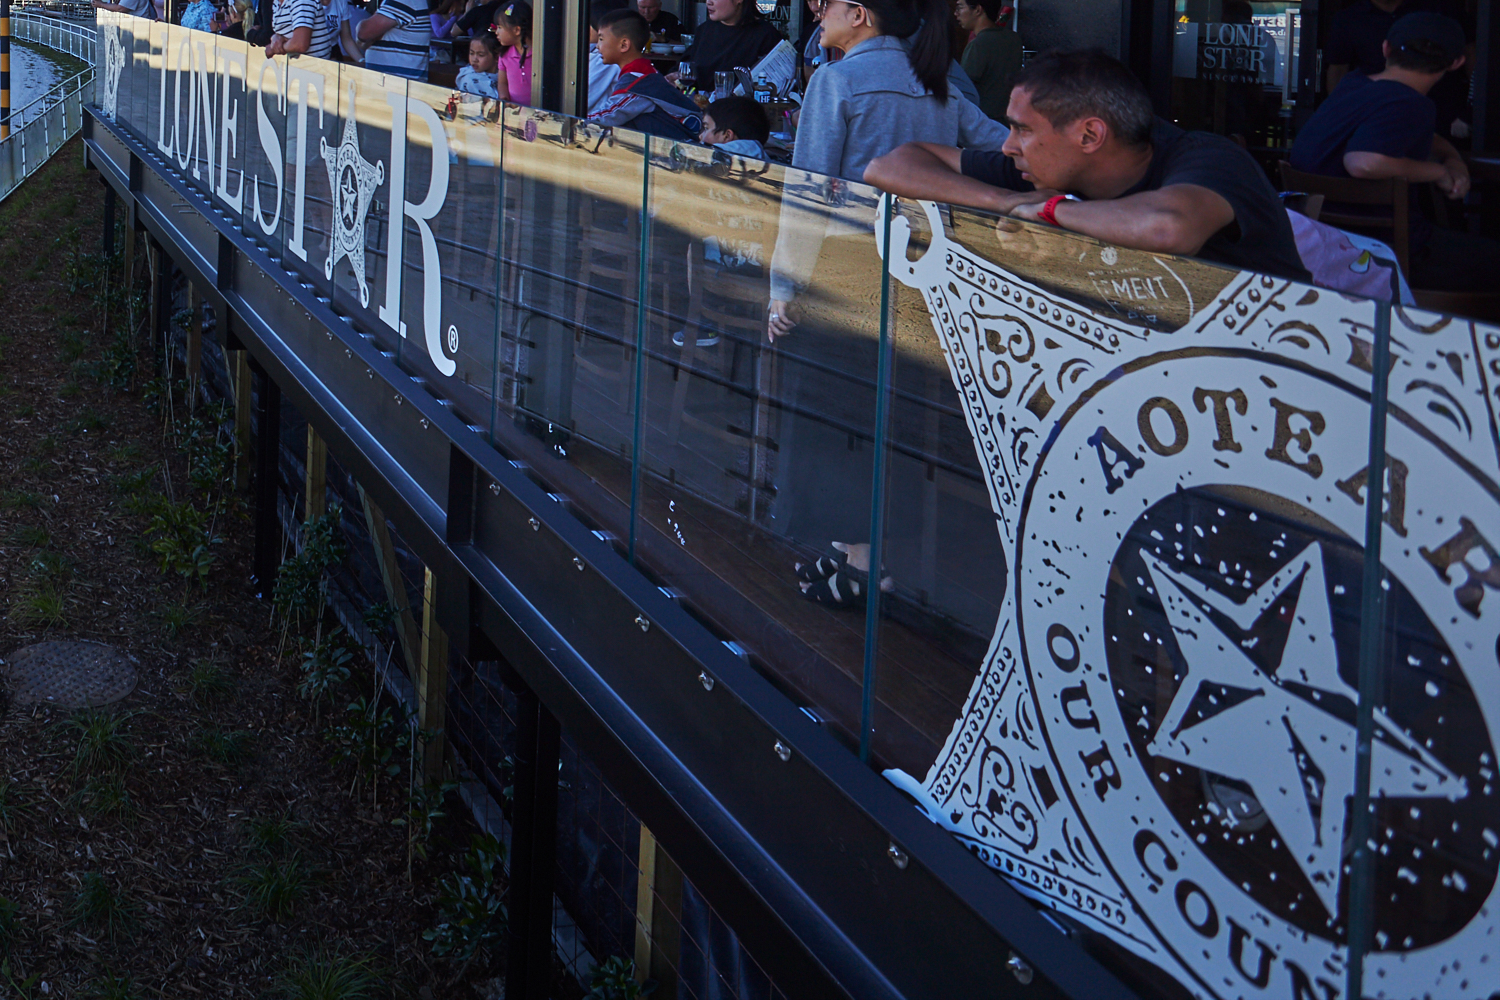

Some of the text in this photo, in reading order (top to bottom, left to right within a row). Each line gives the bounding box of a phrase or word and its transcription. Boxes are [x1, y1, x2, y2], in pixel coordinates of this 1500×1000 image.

[157, 32, 247, 215] LONE
[1204, 23, 1268, 48] LONE
[1087, 387, 1500, 620] AOTEAR
[1046, 623, 1342, 1000] OUR COUN
